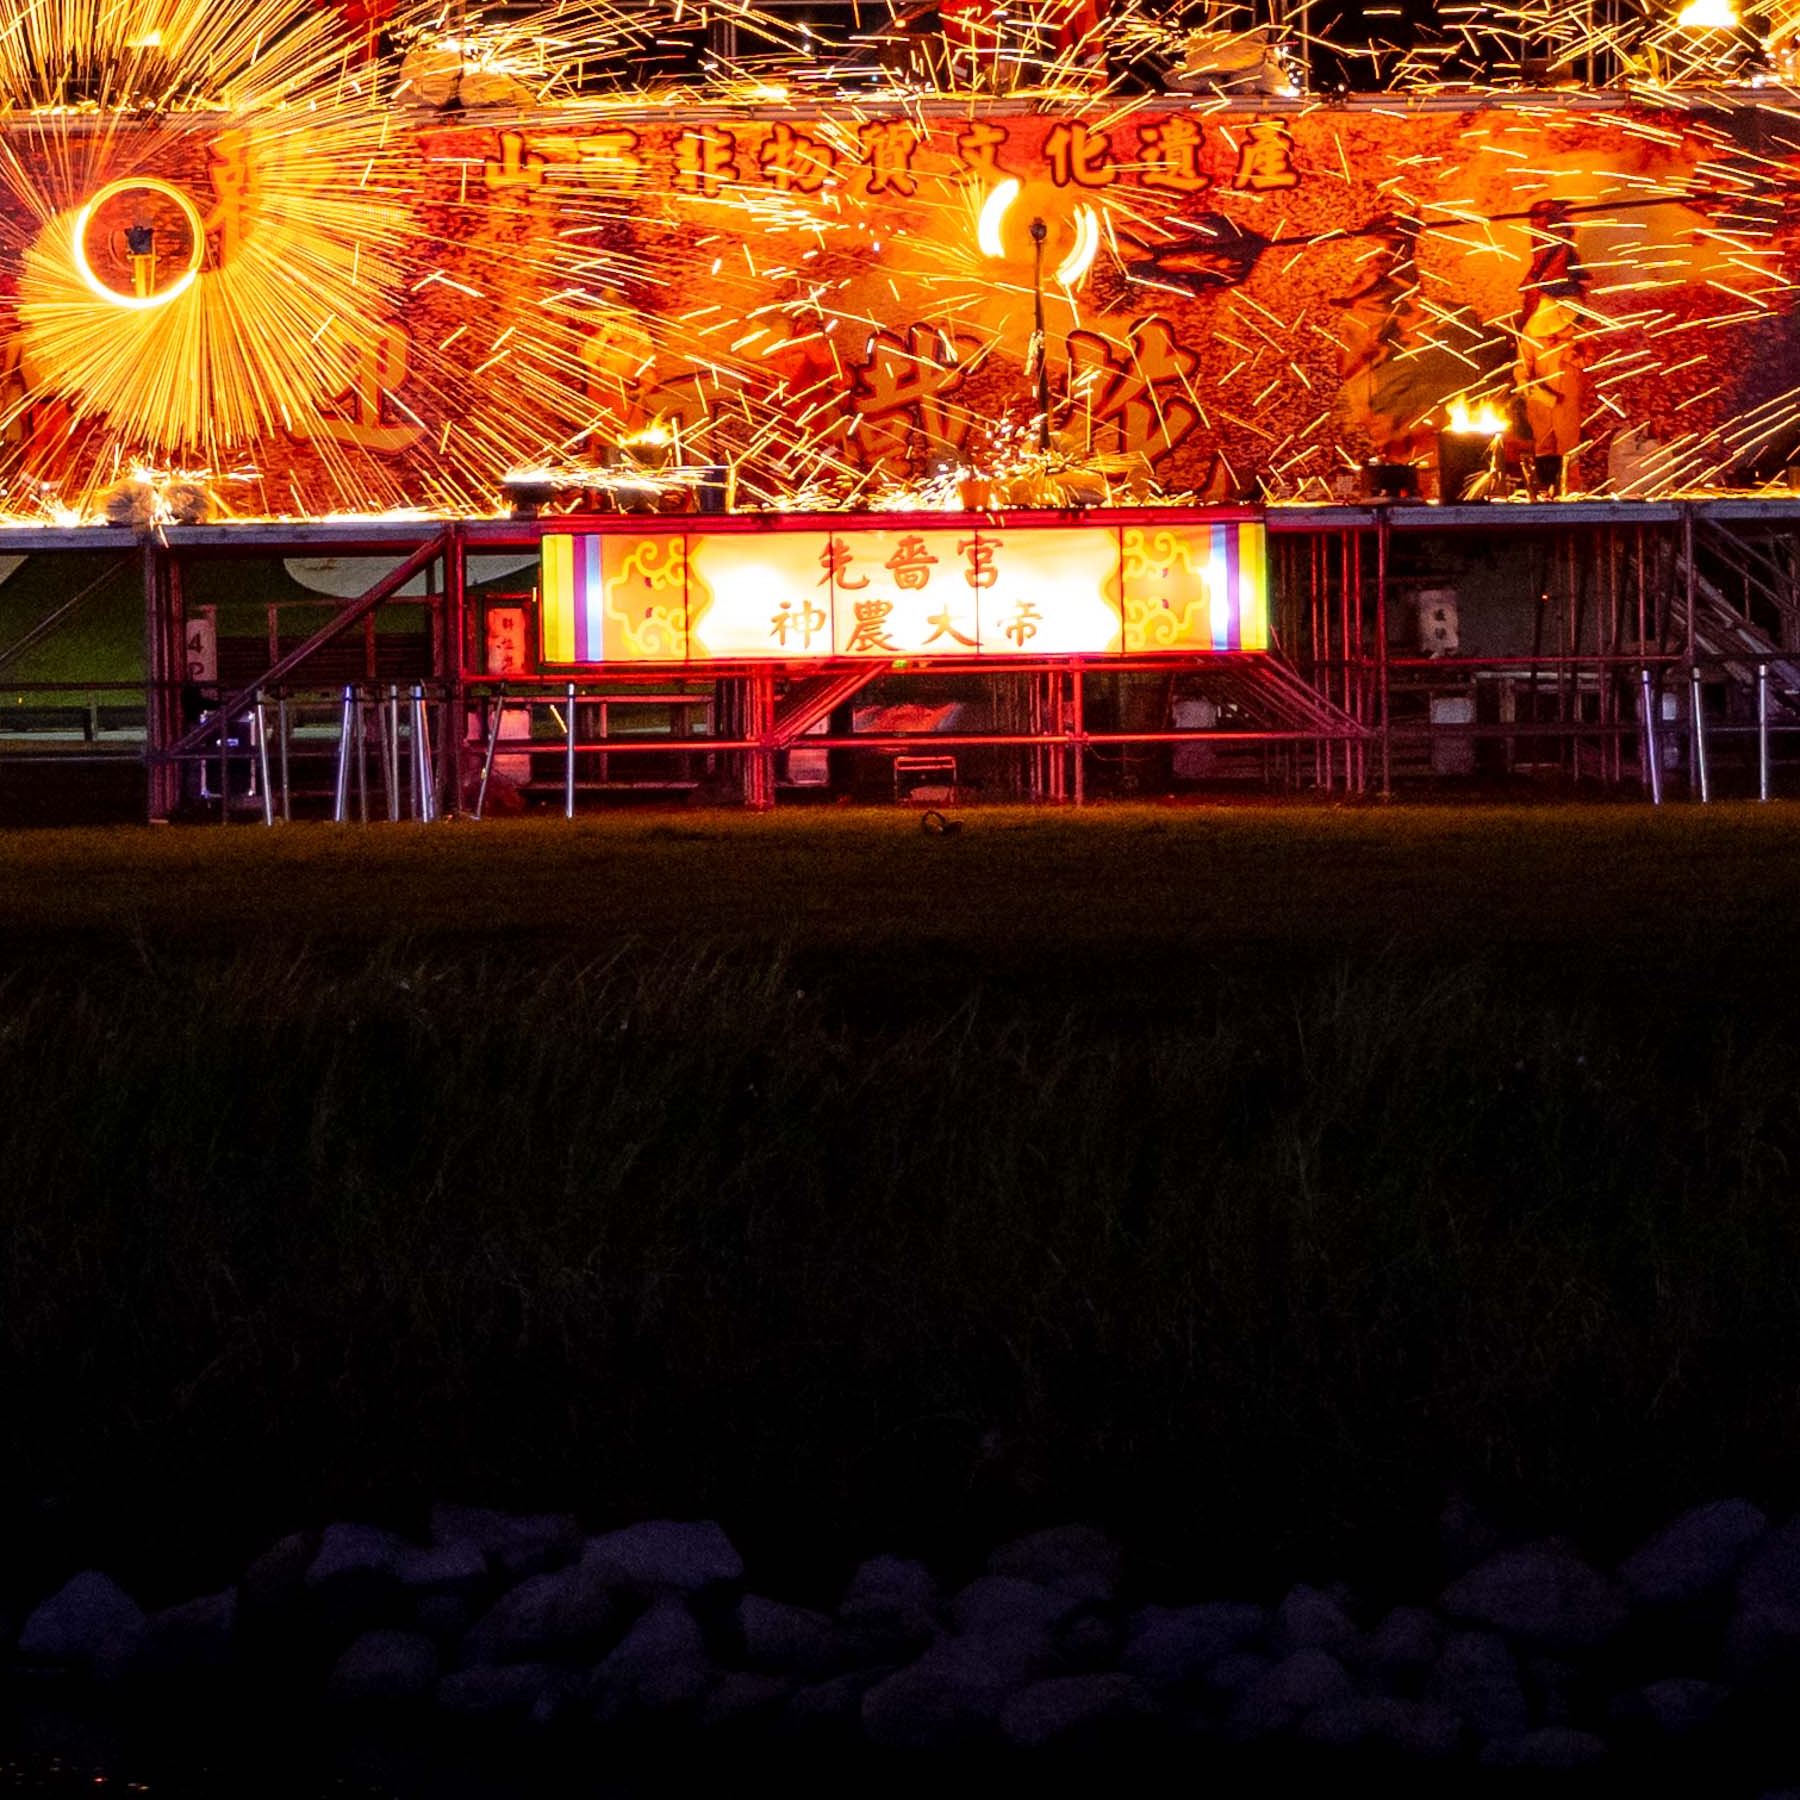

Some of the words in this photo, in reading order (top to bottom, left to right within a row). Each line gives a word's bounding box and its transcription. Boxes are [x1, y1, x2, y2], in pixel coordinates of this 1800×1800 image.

[816, 535, 1004, 591] 先嗇宮
[769, 600, 1044, 652] 神農大帝
